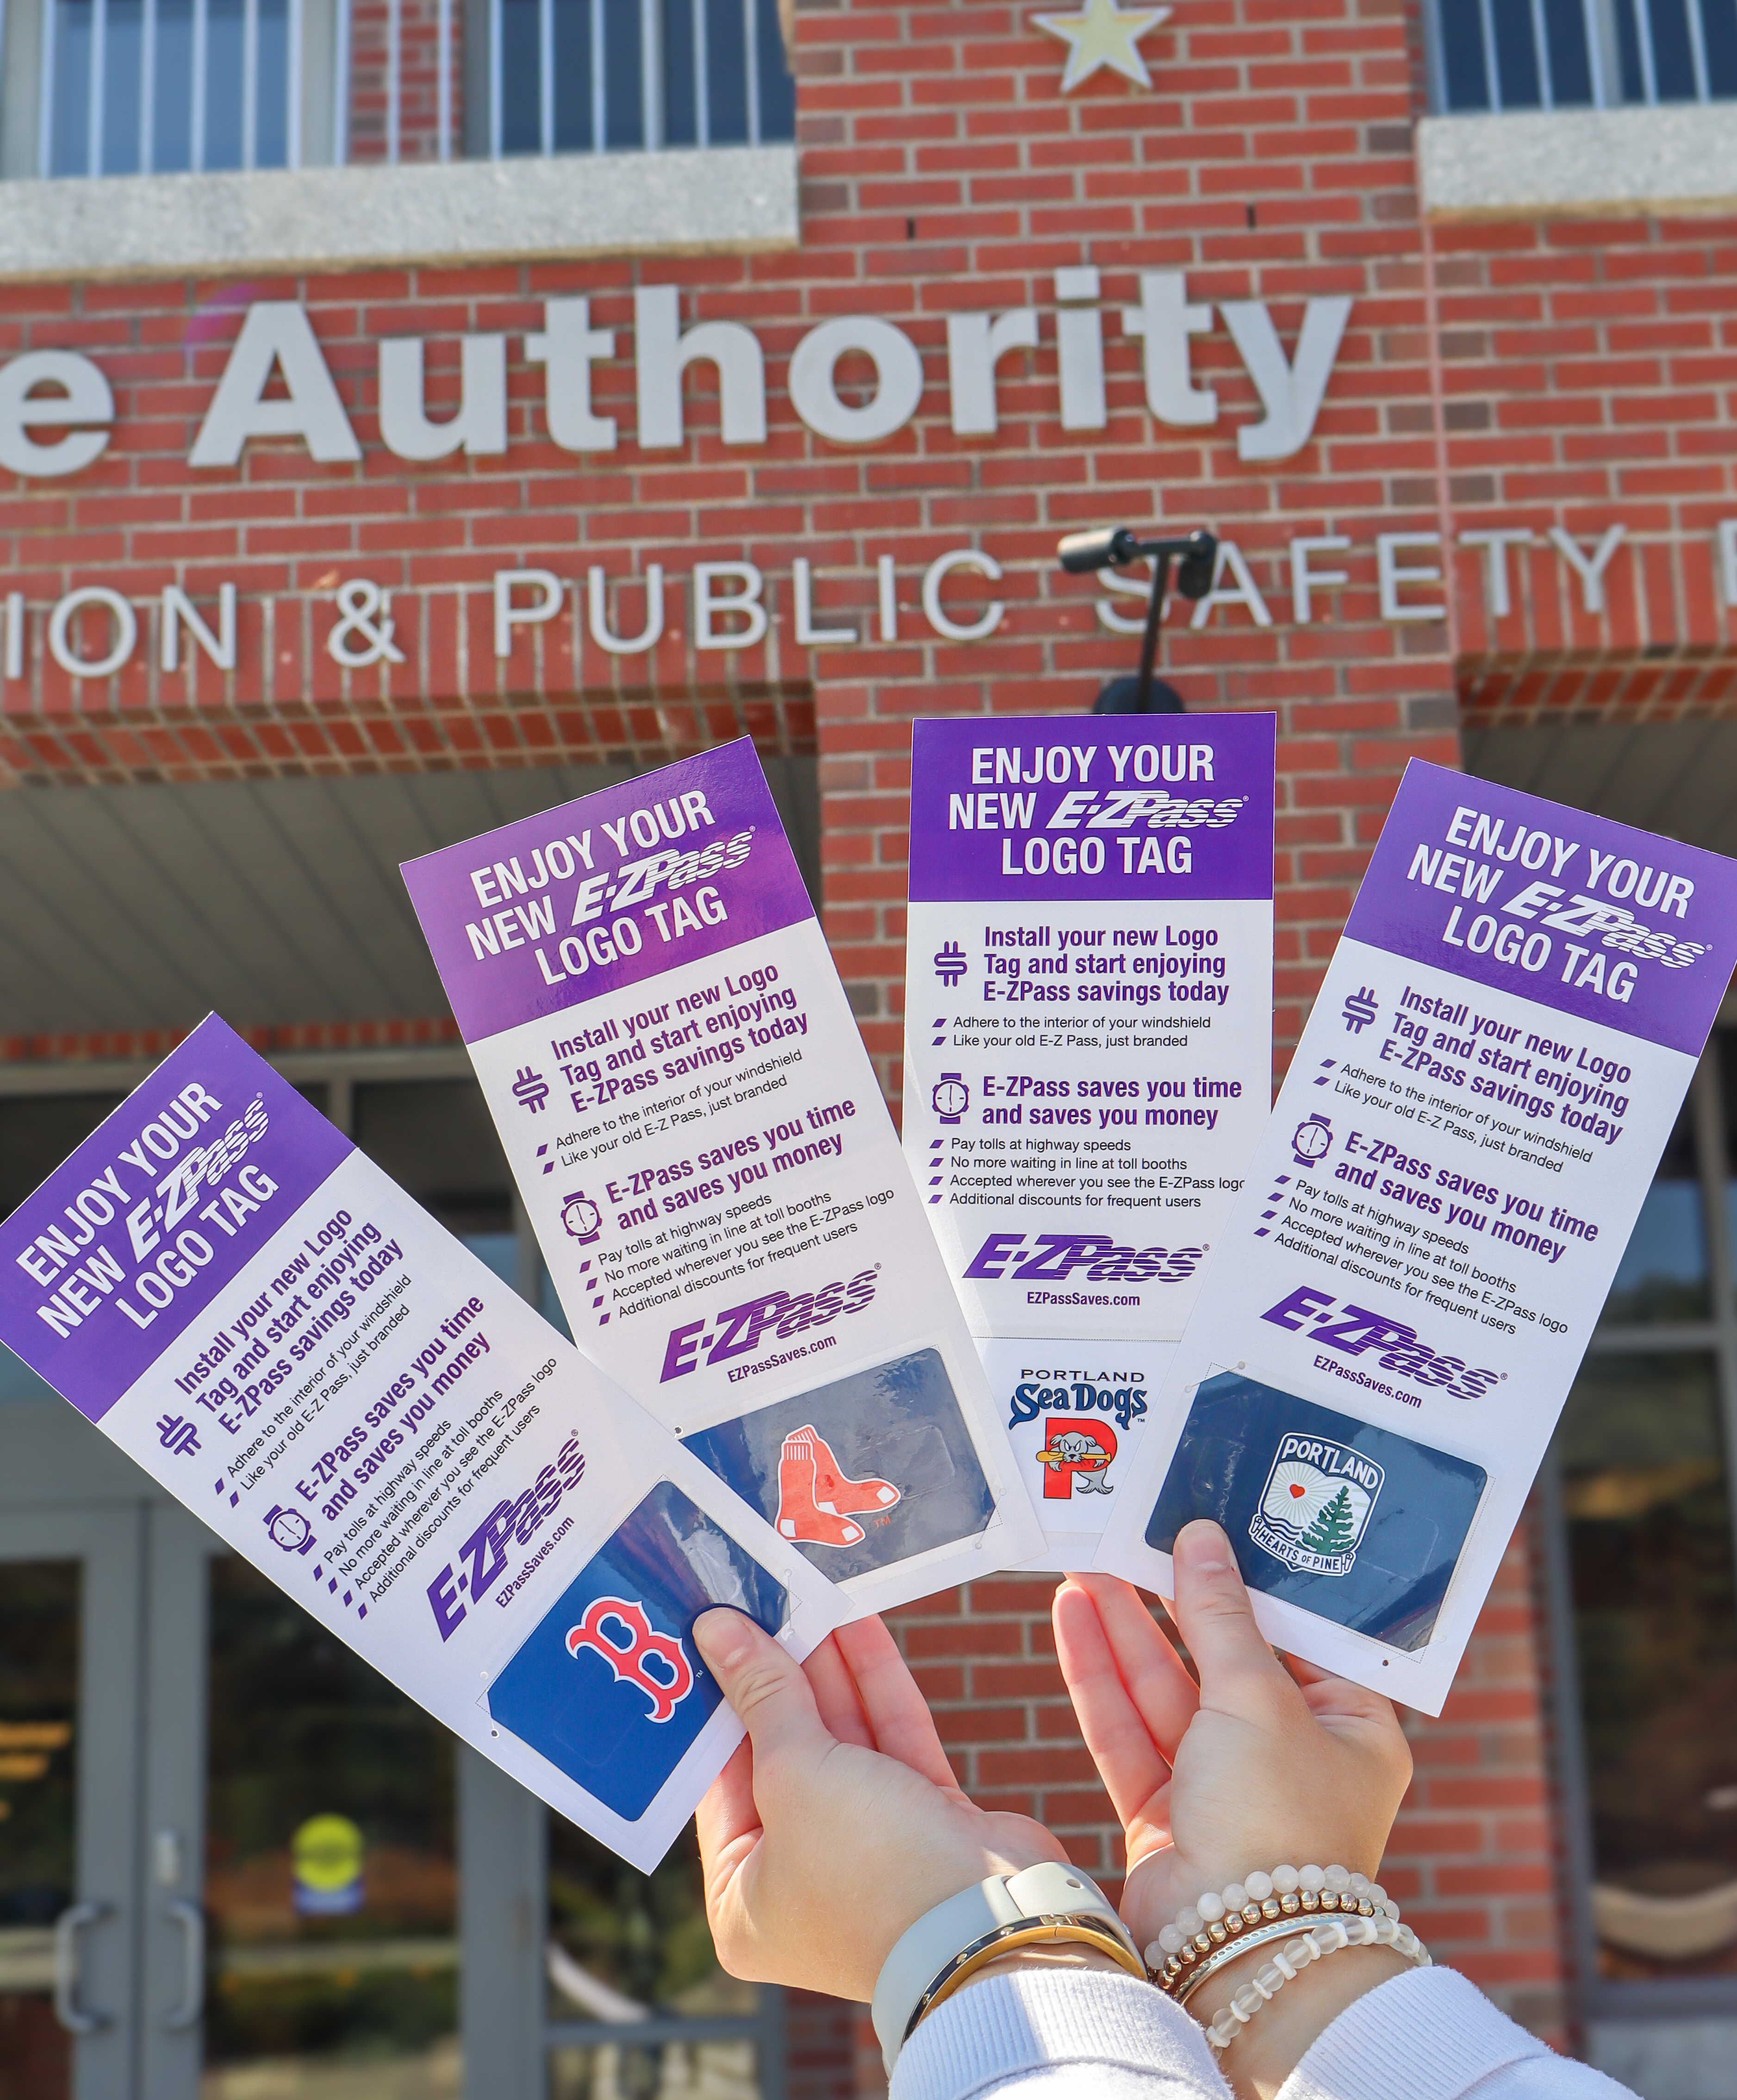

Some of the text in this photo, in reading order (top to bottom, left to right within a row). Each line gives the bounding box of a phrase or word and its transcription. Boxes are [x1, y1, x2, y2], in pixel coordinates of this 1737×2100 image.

[187, 266, 1353, 468] Authority
[327, 578, 406, 668] &
[494, 549, 1005, 658] PUBLIC
[949, 792, 1037, 830] NEW
[972, 745, 1214, 784] ENJOY YOUR
[469, 790, 716, 908] ENJOY YOUR
[1002, 836, 1192, 875] LOGO TAG
[1406, 843, 1505, 904] NEW
[1444, 806, 1695, 919] ENJOY YOUR
[465, 895, 556, 961] NEW
[534, 886, 728, 986] LOGO TAG
[985, 925, 1218, 951] Install your new Logo
[1442, 905, 1638, 1003] LOGO TAG
[569, 1012, 808, 1113] E-ZPass savings today
[953, 1016, 1211, 1031] Adhere to the interior of your windshield
[1392, 1011, 1630, 1118] Tag and start enjoying
[1399, 985, 1631, 1084] Install your new Logo
[556, 1048, 803, 1150] Adhere to the interior of your windshield
[560, 1074, 788, 1167] Like your old E-Z Pass, just branded
[951, 1137, 1132, 1154] Pay tolls at highway speeds
[15, 1082, 224, 1287] ENJOY YOUR
[605, 1100, 856, 1205] E-ZPass saves you time
[617, 1133, 842, 1230] and saves you money
[951, 1156, 1188, 1172] No more waiting in line at toll booths
[1344, 1130, 1599, 1242] E-ZPass saves you time
[36, 1244, 126, 1339] NEW
[114, 1164, 280, 1330] LOGO TAG
[1273, 1232, 1517, 1335] Additional discounts for frequent users
[1280, 1215, 1569, 1334] Accepted wherever you see the E-ZPass logo
[173, 1209, 352, 1396] Install your new Logo
[194, 1222, 382, 1413] Tag and start enjoying
[217, 1238, 404, 1435] E-ZPass savings today
[1027, 1291, 1140, 1306] EZPassSaves.com
[294, 1297, 485, 1503] E-ZPass saves you time
[727, 1336, 838, 1384] EZPassSaves.com
[1020, 1369, 1145, 1383] PORTLAND
[1313, 1354, 1422, 1409] EZPassSaves.com
[323, 1420, 452, 1564] Pay tolls at highway speeds
[369, 1405, 541, 1603] Additional discounts for frequent users
[1281, 1437, 1379, 1490] PORTLAND
[494, 1516, 575, 1609] EZPassSaves.com
[1258, 1528, 1300, 1561] HEARTS
[1312, 1556, 1340, 1571] PINE
[565, 1595, 694, 1724] B
